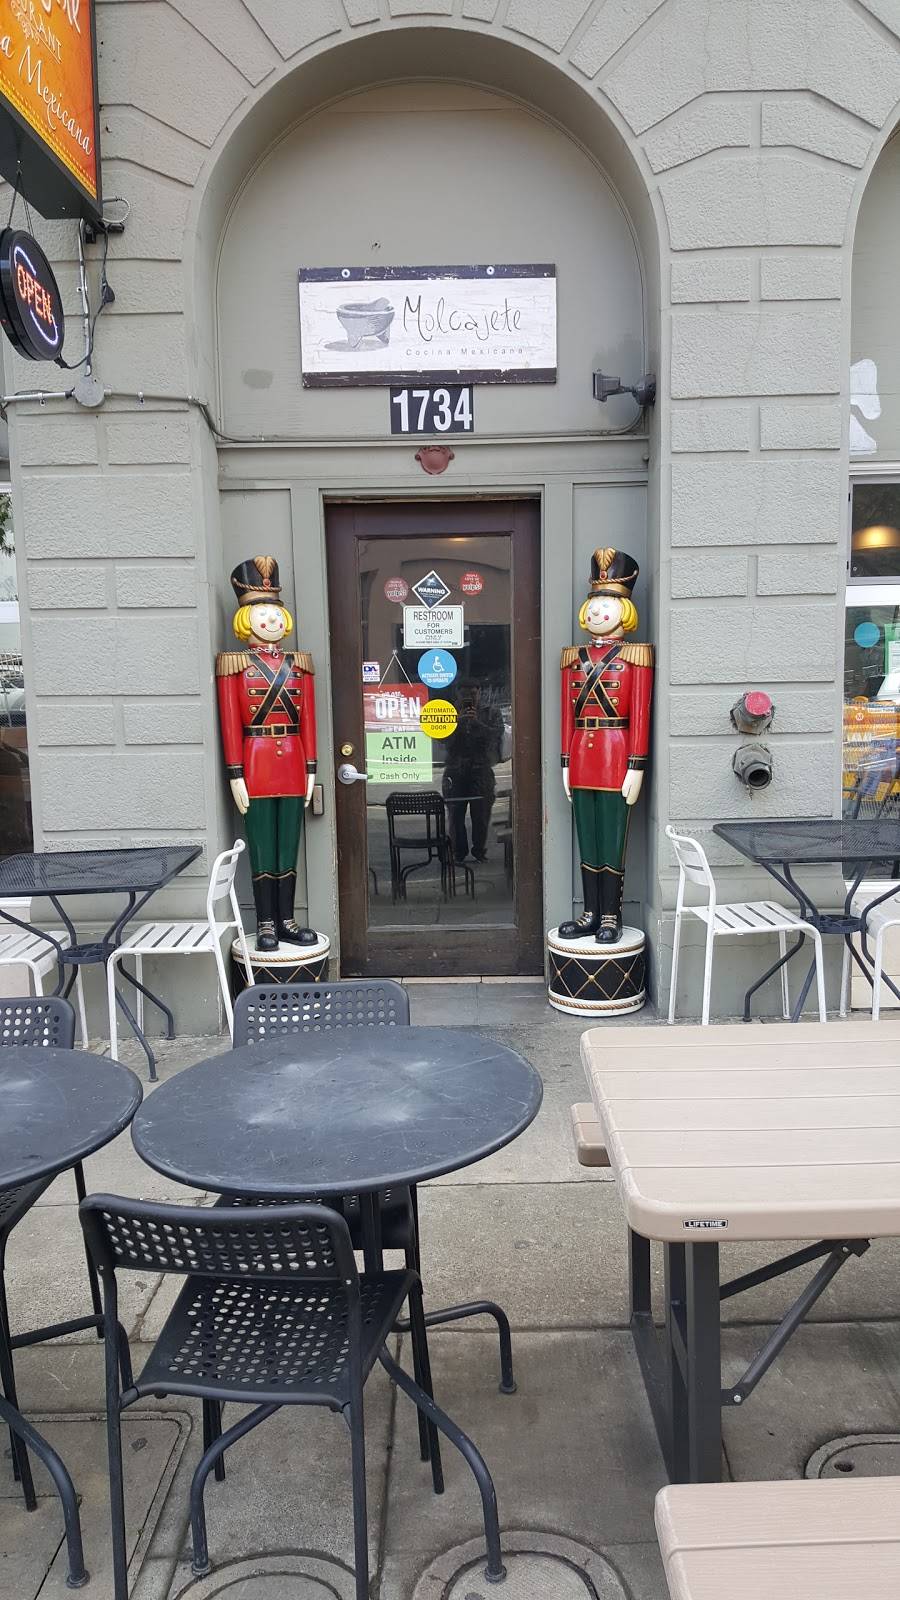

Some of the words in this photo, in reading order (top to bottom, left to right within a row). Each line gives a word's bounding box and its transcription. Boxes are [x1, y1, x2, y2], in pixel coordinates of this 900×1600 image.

[18, 45, 92, 155] Mexicana
[17, 264, 52, 324] OPEN
[403, 295, 521, 342] Molcajete
[406, 348, 451, 356] Cocina
[461, 347, 524, 355] Mexicana
[392, 387, 473, 432] 1734
[417, 586, 446, 595] WARNING
[413, 611, 454, 620] RESTROOM
[375, 697, 420, 719] OPEN
[421, 715, 456, 723] CAUTION
[381, 736, 416, 749] ATM
[382, 754, 417, 764] Inside
[379, 772, 400, 780] Cash
[401, 771, 420, 781] Only
